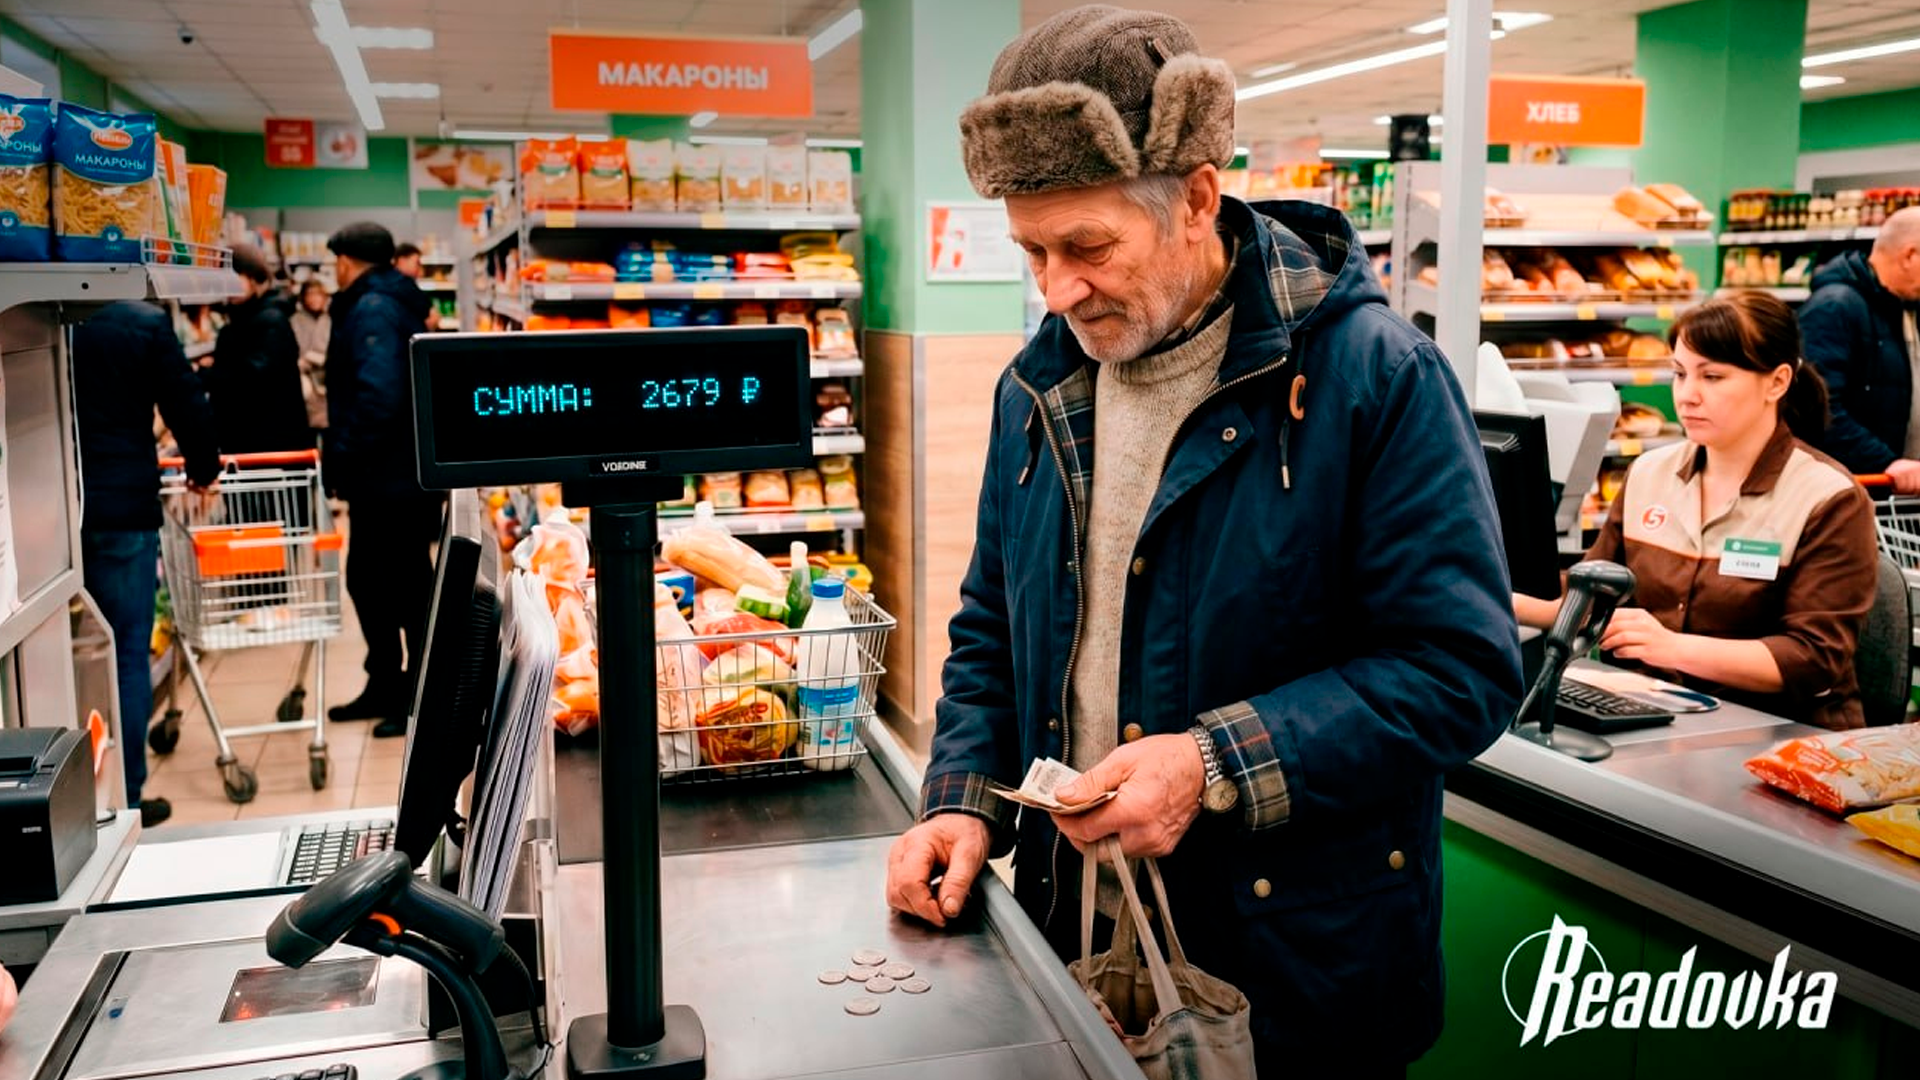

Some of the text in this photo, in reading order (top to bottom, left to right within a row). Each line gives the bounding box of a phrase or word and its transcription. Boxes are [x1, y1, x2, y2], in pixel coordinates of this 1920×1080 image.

[597, 60, 769, 91] МАКАРОНЫ
[1525, 101, 1582, 124] ХЛЕБ
[74, 153, 147, 171] МАКАРОНЫ
[473, 376, 761, 416] СУММА: 2679 ₽
